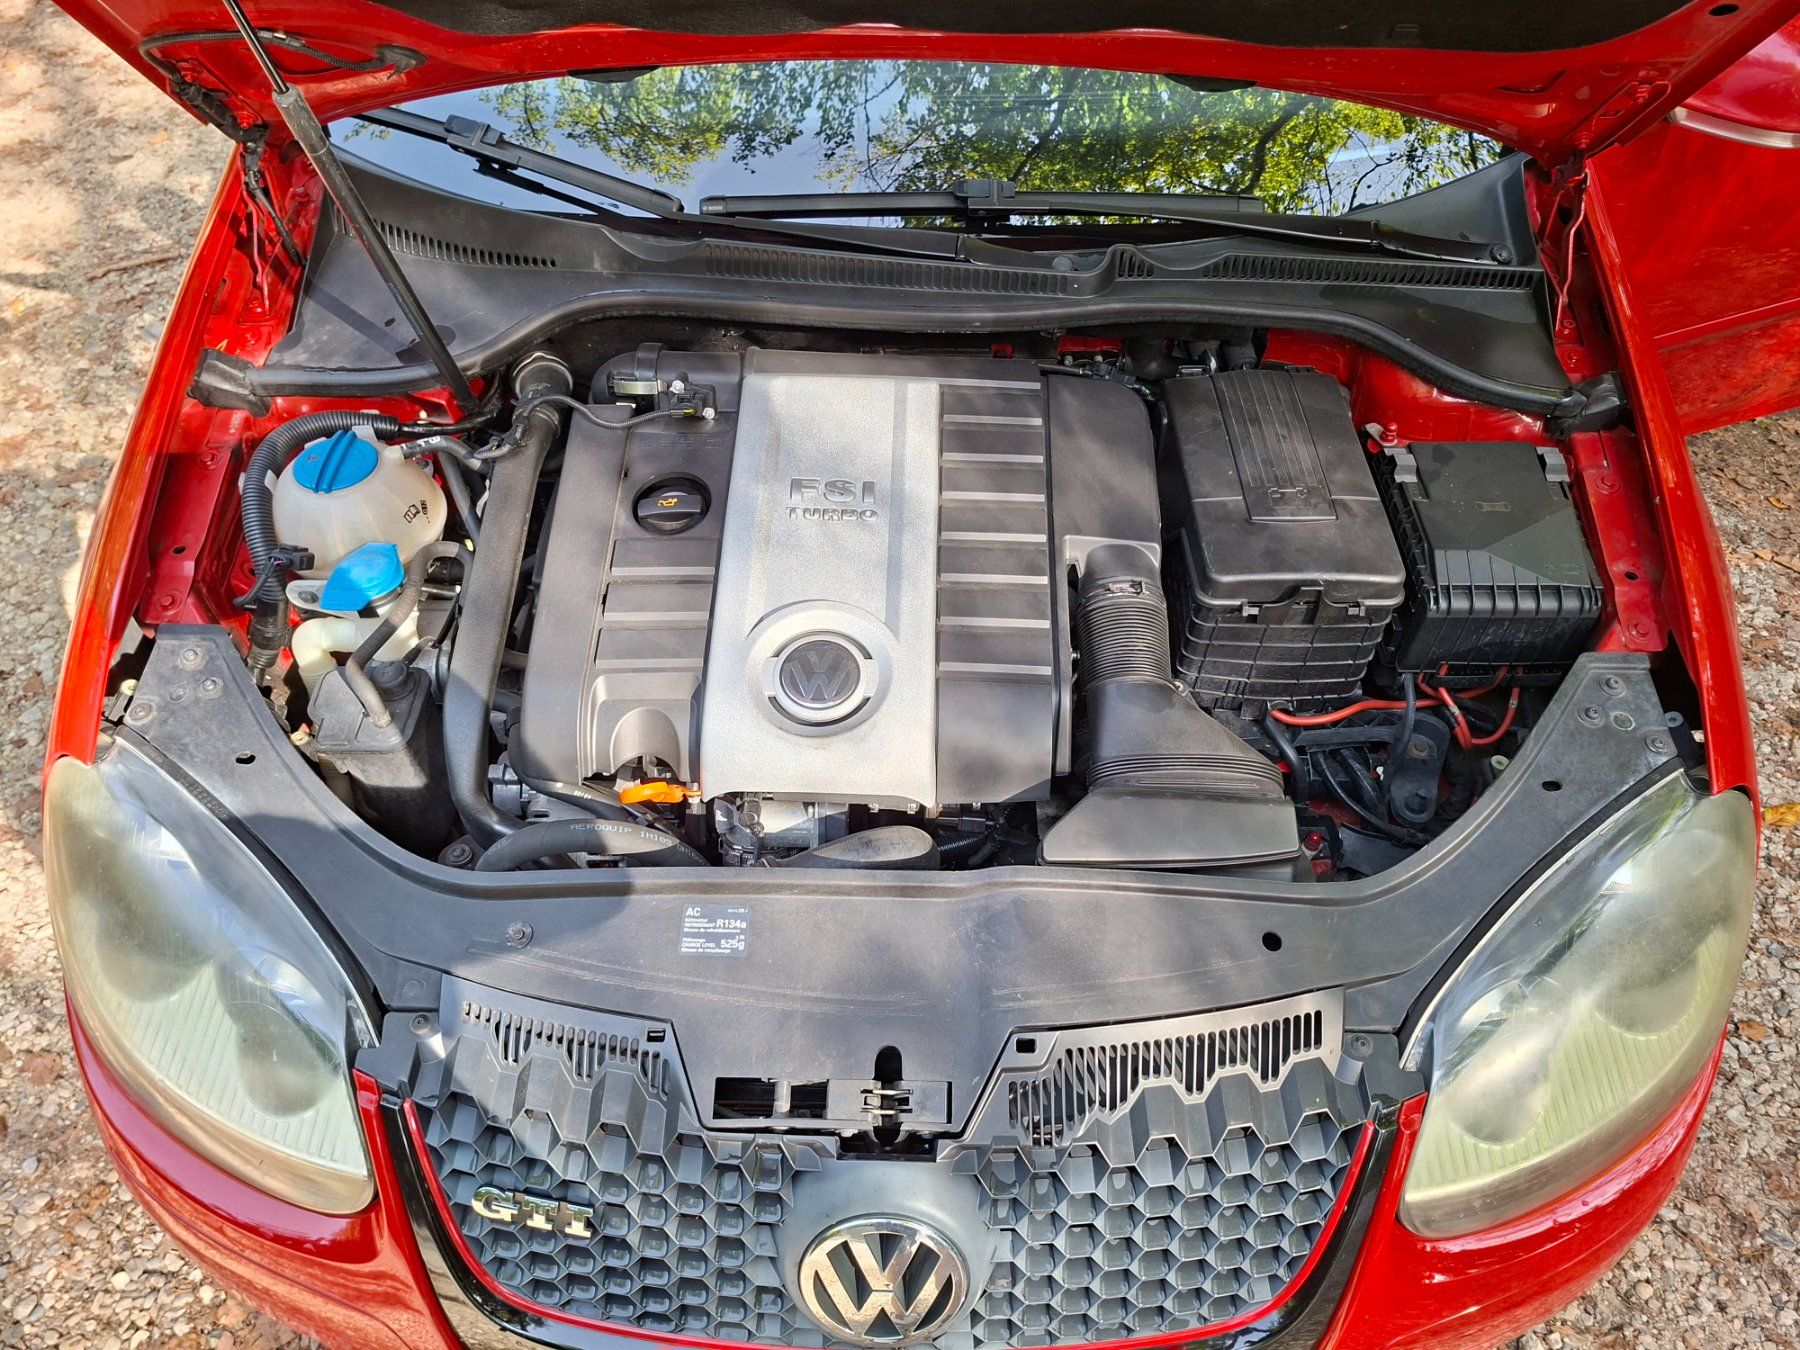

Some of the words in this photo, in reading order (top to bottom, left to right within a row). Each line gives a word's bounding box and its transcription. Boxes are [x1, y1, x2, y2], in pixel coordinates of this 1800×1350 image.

[789, 477, 876, 504] FSI
[786, 507, 878, 521] TURBO
[686, 908, 701, 916] AC
[717, 919, 746, 928] R134a
[471, 1186, 595, 1239] GTI
